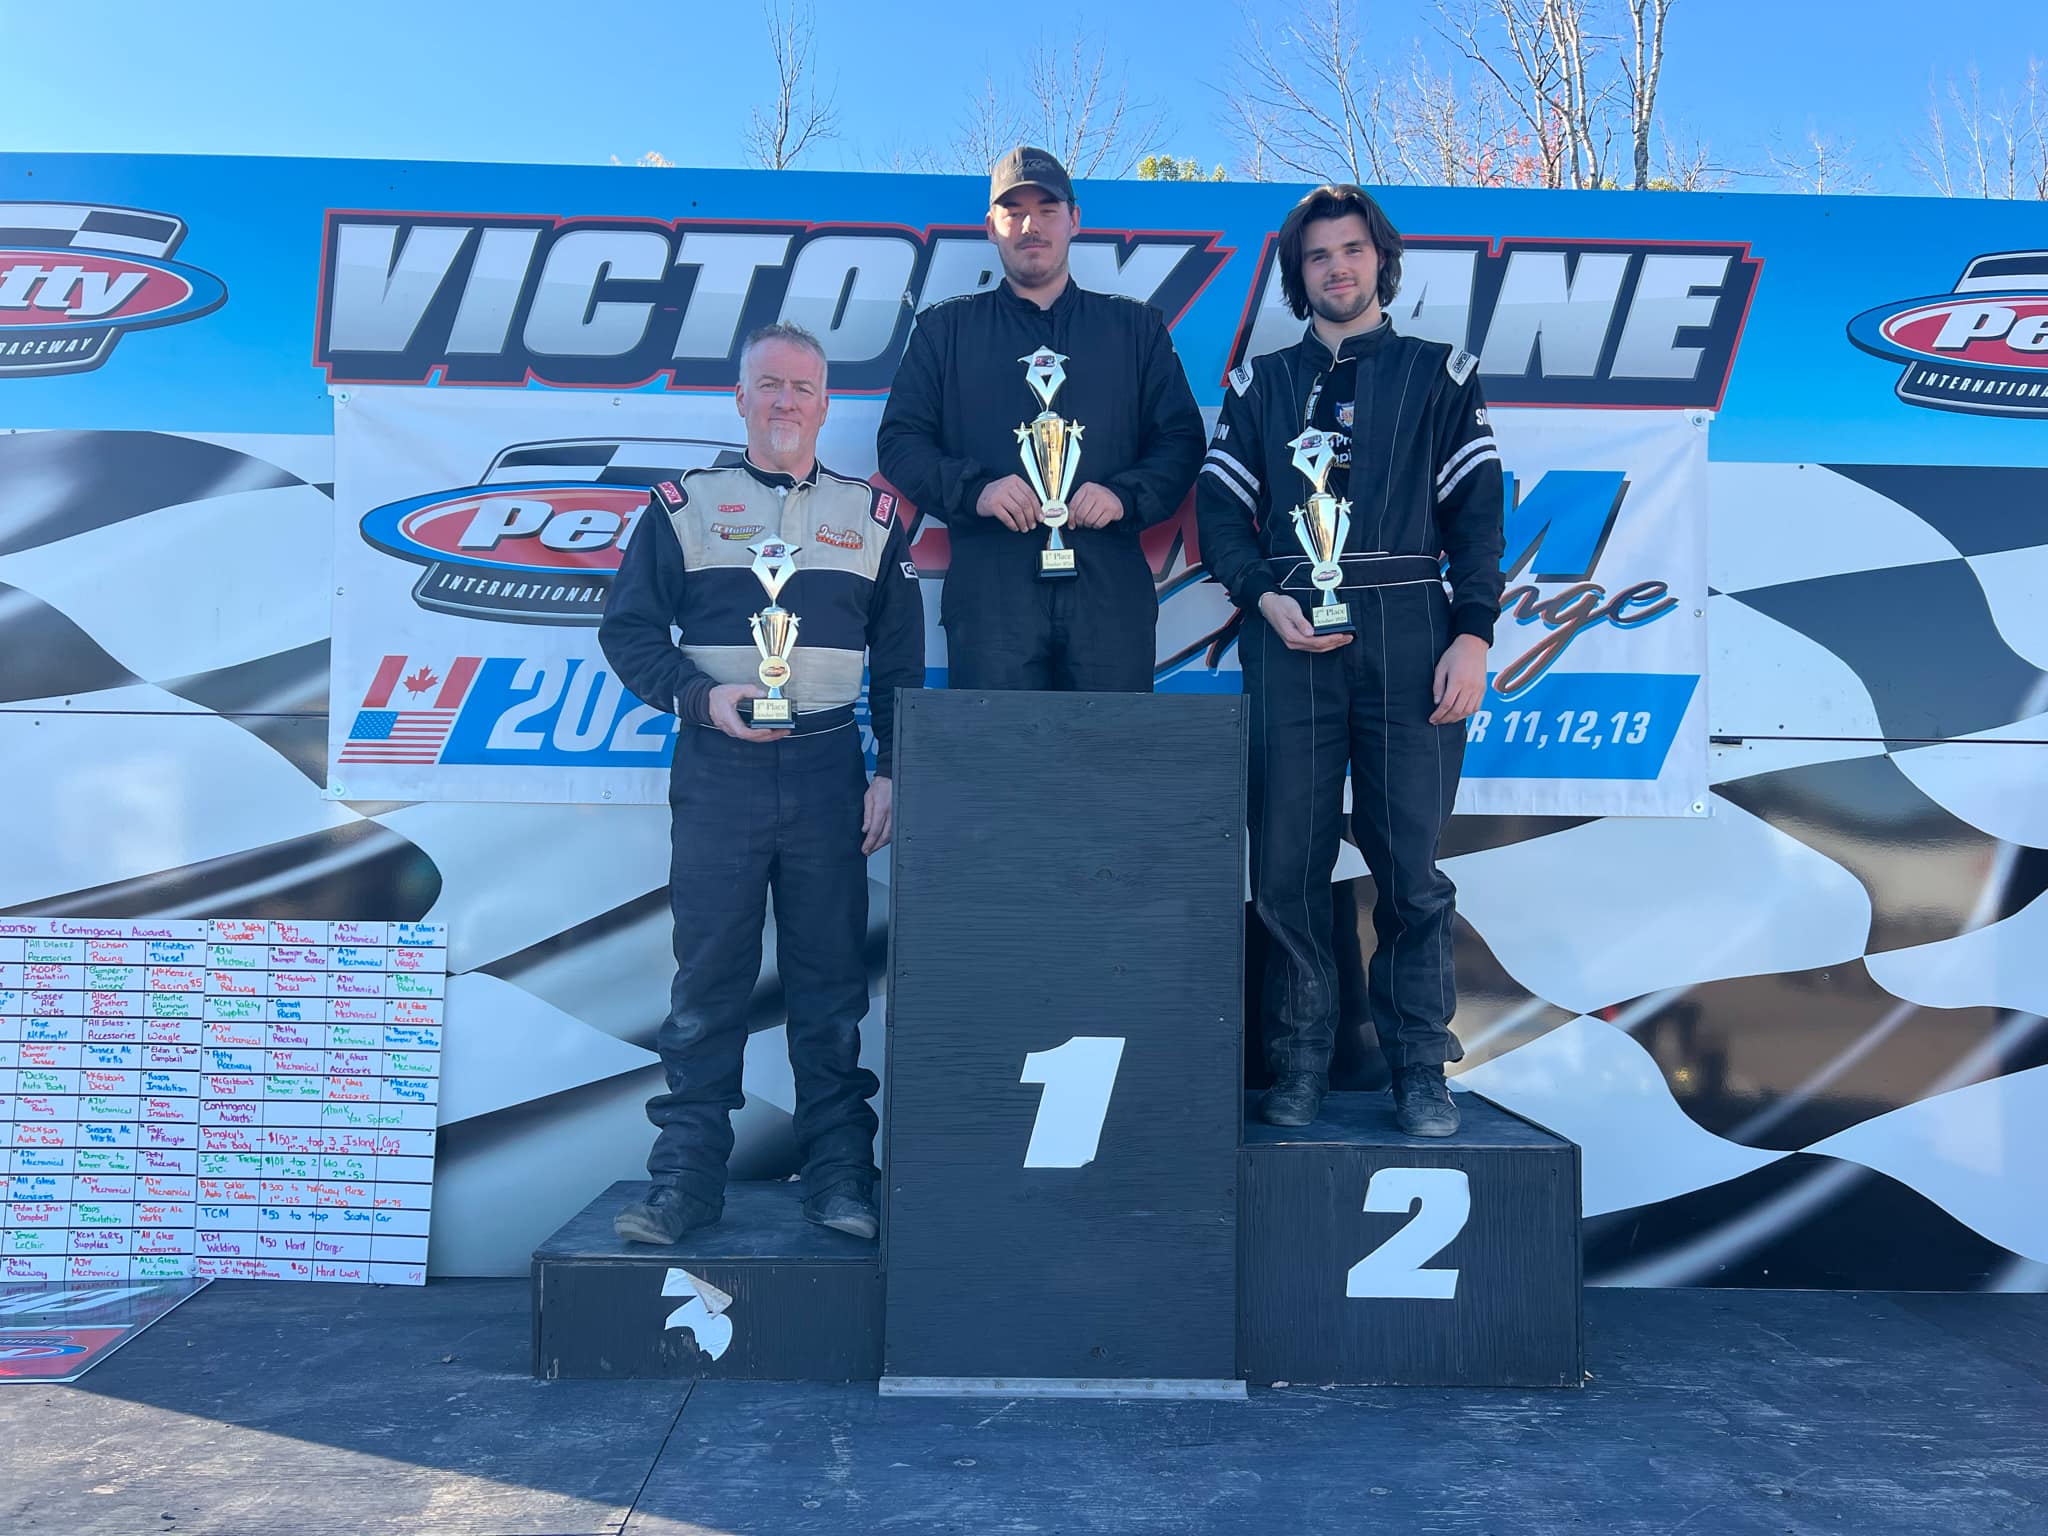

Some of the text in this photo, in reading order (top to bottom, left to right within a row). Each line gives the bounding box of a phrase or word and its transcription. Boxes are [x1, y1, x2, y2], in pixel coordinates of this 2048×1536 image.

[438, 572, 604, 603] INTERNATIONAL
[1504, 710, 1651, 749] 11,12,13
[62, 923, 122, 939] Contingency
[132, 925, 173, 938] Awards
[334, 933, 379, 944] Mechanical
[150, 952, 184, 962] Diesel
[150, 979, 189, 991] Racing
[31, 991, 64, 1000] Sussex
[91, 992, 117, 1001] Albert
[152, 993, 184, 1002] Atlantic
[213, 998, 261, 1013] KCM Safety
[335, 1010, 378, 1020] Mechanical
[88, 1019, 124, 1027] All Glass
[150, 1020, 181, 1031] Eugene
[210, 1023, 233, 1034] AJW
[88, 1029, 136, 1040] Accessories
[148, 1032, 181, 1043] Weagle
[215, 1034, 262, 1046] Mechanical
[151, 1053, 183, 1064] Campbell
[276, 1062, 319, 1073] Mechanical
[329, 1065, 371, 1075] Accessories
[146, 1081, 188, 1093] Insulation
[328, 1091, 370, 1101] Accessories
[1020, 1036, 1126, 1168] 1
[203, 1102, 257, 1114] Contingency
[322, 1103, 351, 1117] Thank
[346, 1112, 362, 1124] You
[202, 1127, 245, 1142] Bingley's
[41, 1135, 64, 1146] Body
[206, 1139, 252, 1153] Auto Body
[307, 1134, 402, 1150] top 3 Island Cars
[311, 1158, 318, 1167] 2
[16, 1176, 29, 1185] All
[223, 1180, 246, 1190] Collar
[16, 1212, 49, 1222] Campbell
[201, 1207, 230, 1219] TCM
[289, 1209, 302, 1221] to
[308, 1210, 330, 1223] top
[343, 1210, 371, 1222] Scotia
[375, 1213, 393, 1223] Car
[1346, 1168, 1471, 1299] 2
[206, 1242, 241, 1255] Welding
[284, 1237, 306, 1251] Hard
[316, 1263, 361, 1280] Hard Luck
